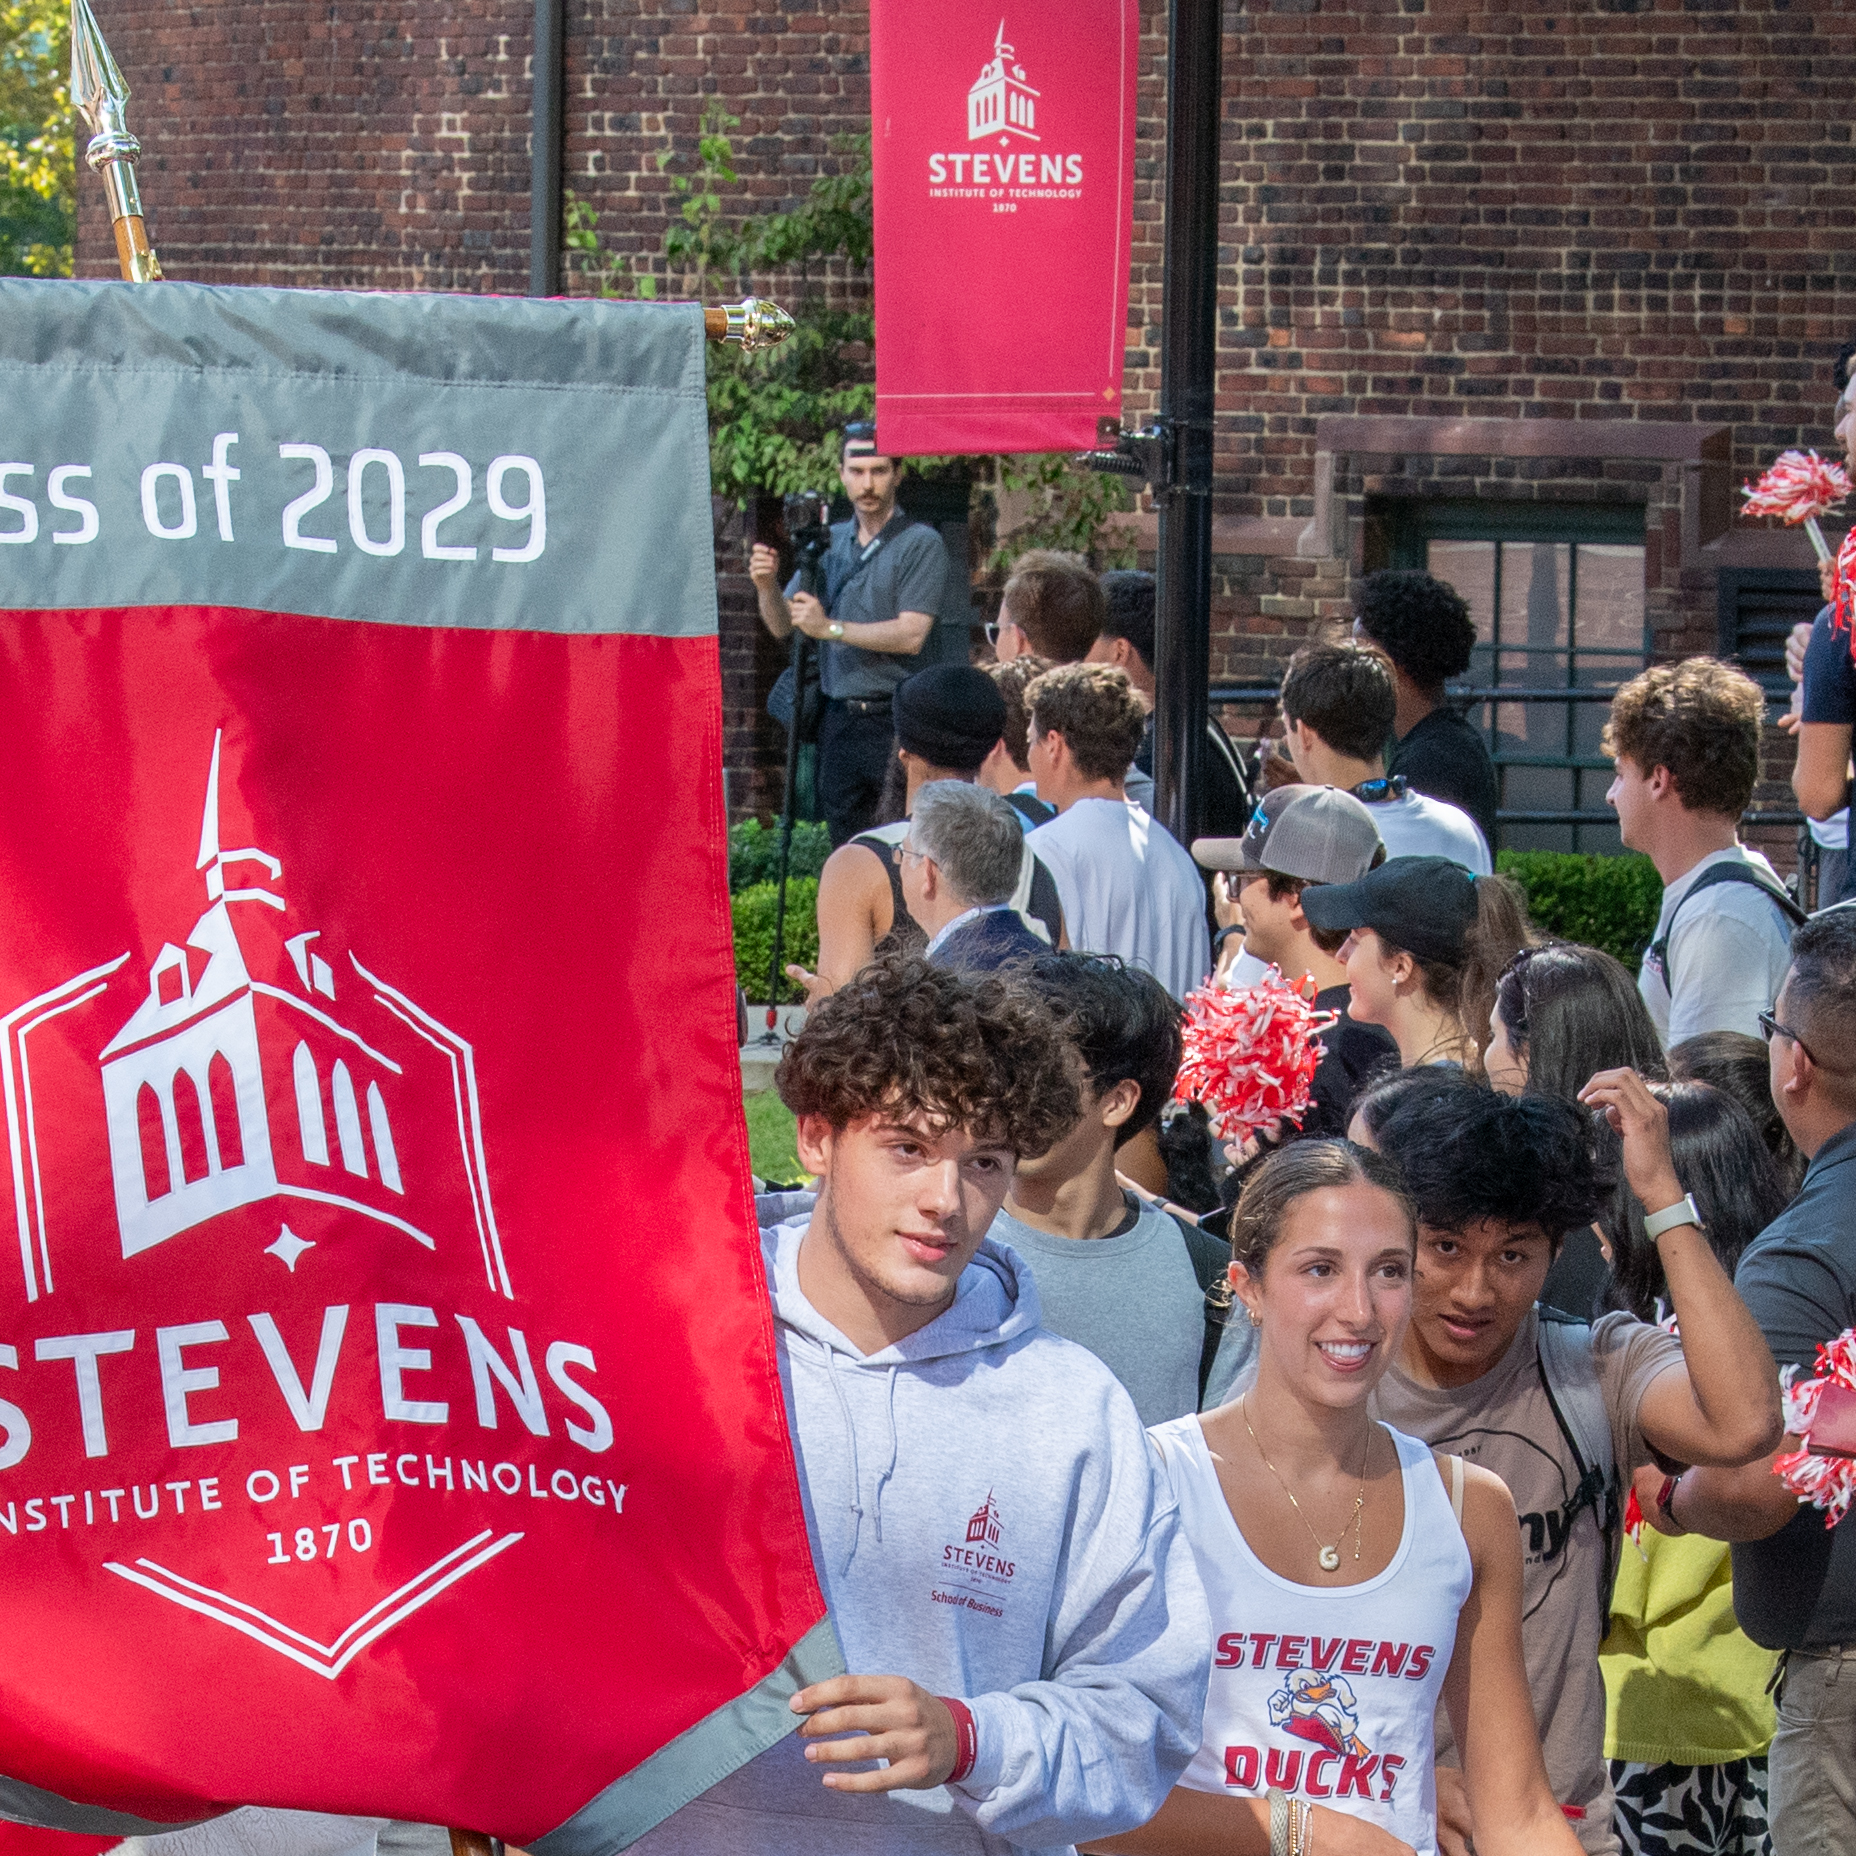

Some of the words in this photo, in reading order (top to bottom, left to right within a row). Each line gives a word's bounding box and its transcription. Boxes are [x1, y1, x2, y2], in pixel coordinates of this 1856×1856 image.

[928, 152, 1084, 184] STEVENS
[929, 188, 985, 198] INSTITUTE
[989, 188, 1005, 198] OF
[1008, 188, 1083, 199] TECHNOLOGY
[993, 203, 1017, 213] 1870
[140, 432, 242, 543] of
[279, 443, 547, 563] 2029
[245, 1464, 310, 1504] OF
[332, 1452, 628, 1515] TECHNOLOGY
[266, 1518, 373, 1565] 1870
[943, 1545, 1016, 1578] STEVENS
[966, 1597, 1004, 1618] Business
[1214, 1631, 1438, 1682] STEVENS
[1224, 1745, 1409, 1803] DUCKS
